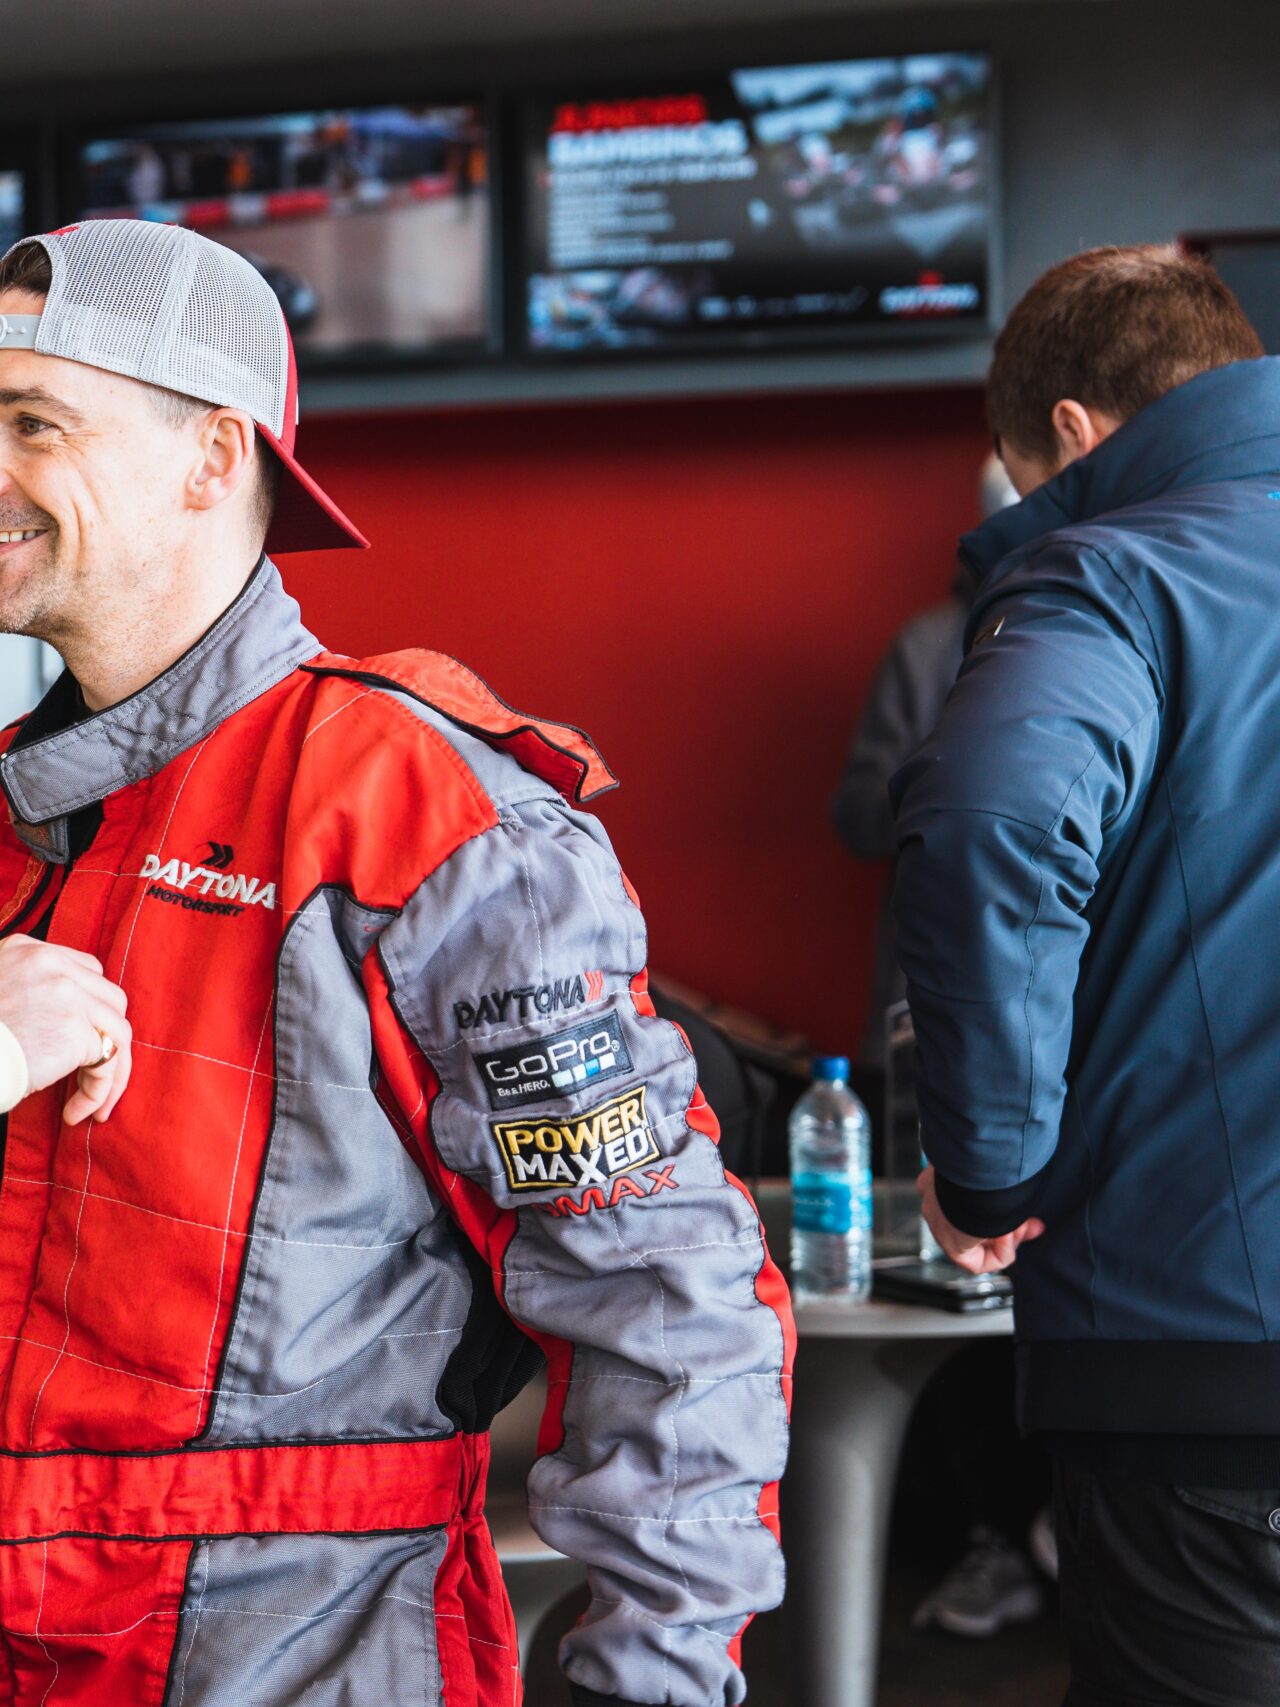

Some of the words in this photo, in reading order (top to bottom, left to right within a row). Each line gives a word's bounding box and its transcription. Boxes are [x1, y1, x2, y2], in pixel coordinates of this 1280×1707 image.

[139, 854, 277, 910] DAYTONA
[453, 974, 585, 1029] DAYTONA
[505, 1098, 642, 1154] POWER
[512, 1128, 650, 1186] MAXED
